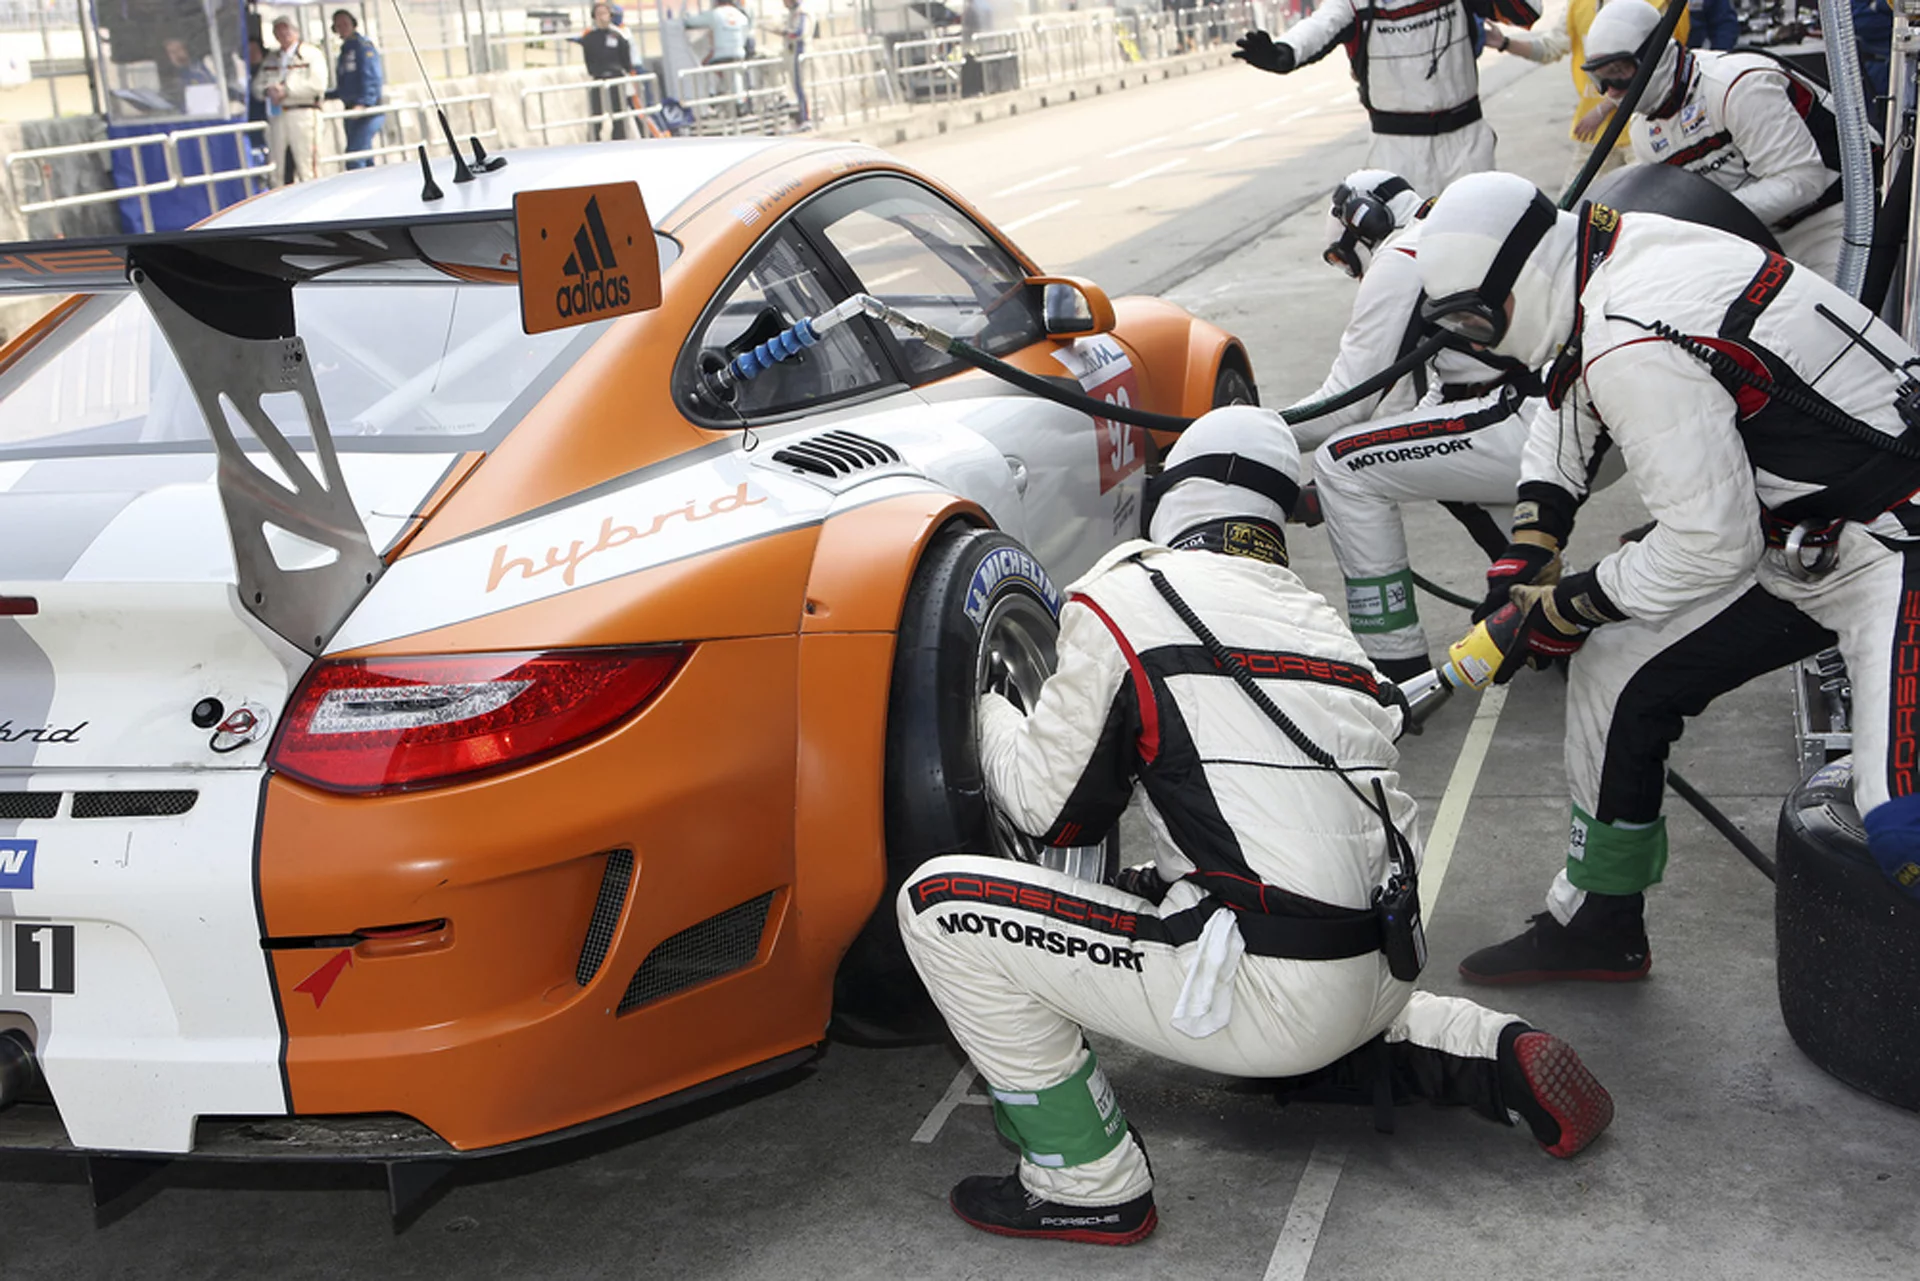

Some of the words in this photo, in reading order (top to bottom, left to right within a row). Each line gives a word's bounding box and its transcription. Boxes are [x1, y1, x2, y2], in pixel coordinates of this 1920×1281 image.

[556, 271, 631, 318] adidas
[1105, 386, 1136, 472] 92
[1335, 419, 1466, 455] PORSCHE
[1346, 437, 1474, 472] MOTORSPORT
[486, 482, 767, 593] hybrid
[980, 550, 1057, 605] MICHELIN
[917, 877, 1138, 934] PORSCHE
[32, 927, 53, 990] 1
[936, 912, 1145, 972] MOTORSPORT
[1041, 1214, 1120, 1226] PORSCHE
